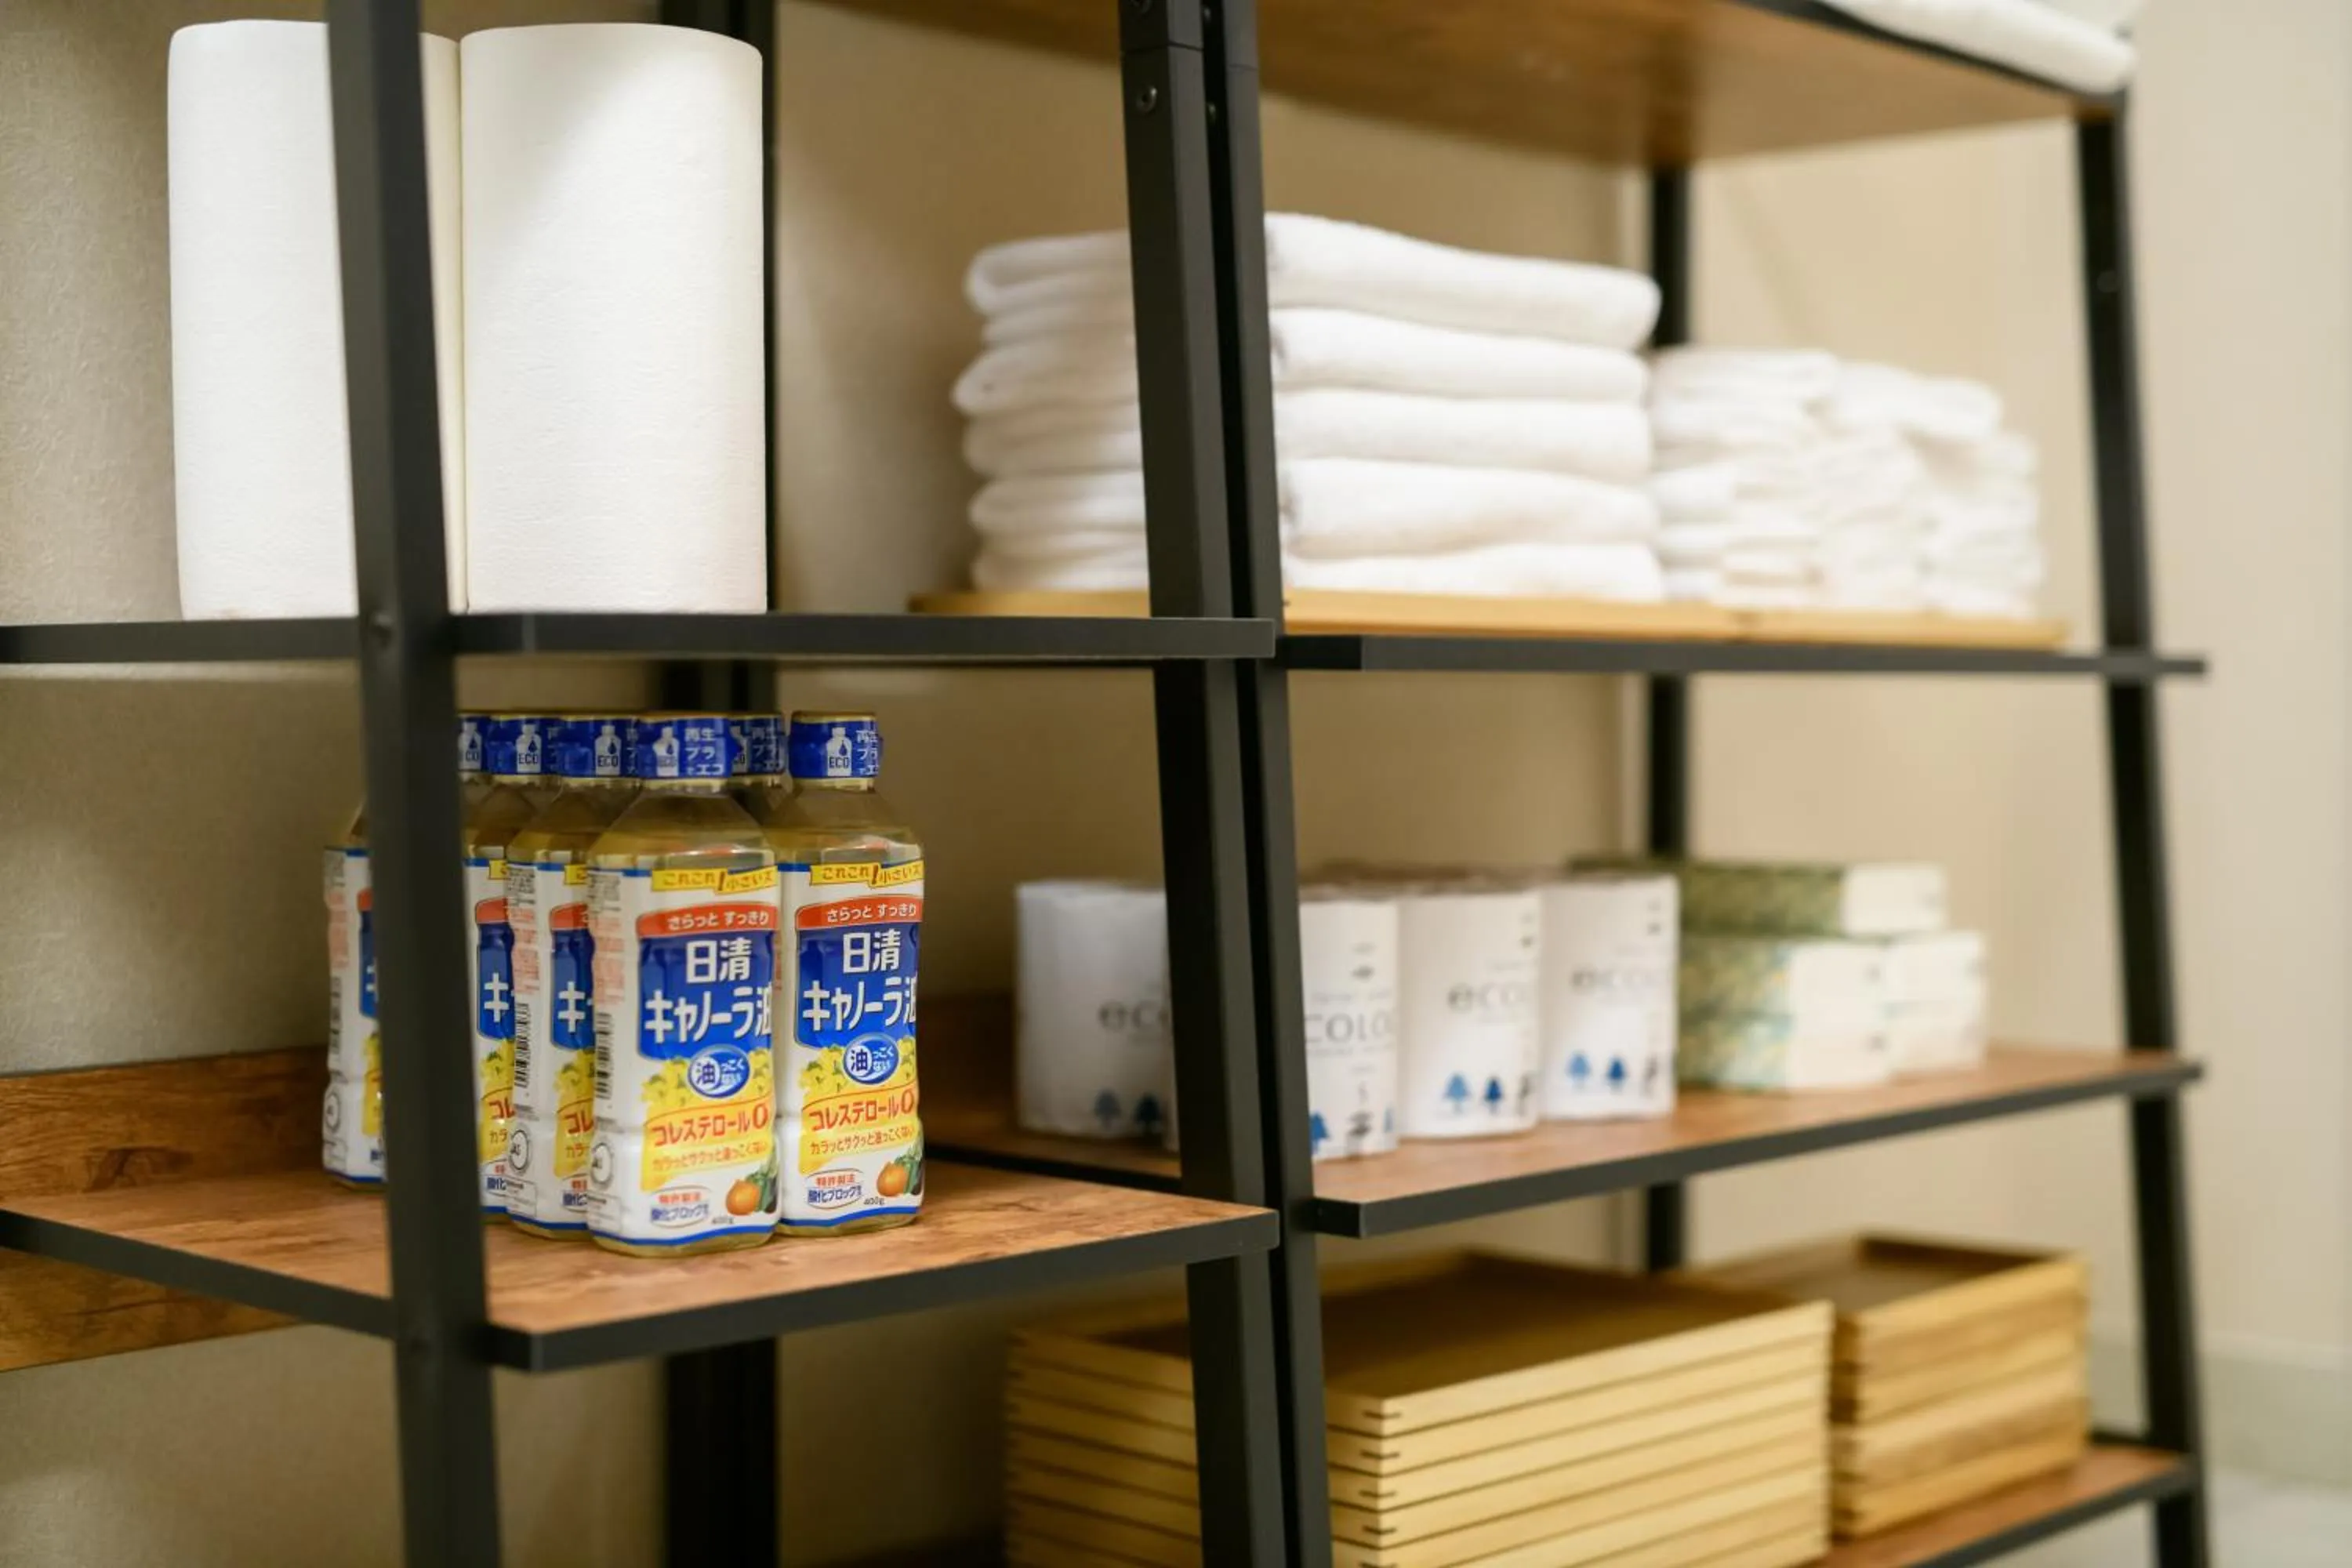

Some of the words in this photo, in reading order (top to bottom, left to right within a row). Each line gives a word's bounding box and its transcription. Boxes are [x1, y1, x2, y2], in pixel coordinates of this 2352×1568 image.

[518, 753, 539, 765] ECO
[597, 755, 619, 767] ECO
[829, 757, 849, 769] ECO
[668, 912, 719, 931] さらっと
[724, 910, 769, 926] すっきり
[827, 906, 873, 923] さらっと
[877, 902, 916, 917] すっきり
[686, 936, 753, 984] 日清
[843, 927, 901, 974] 日清
